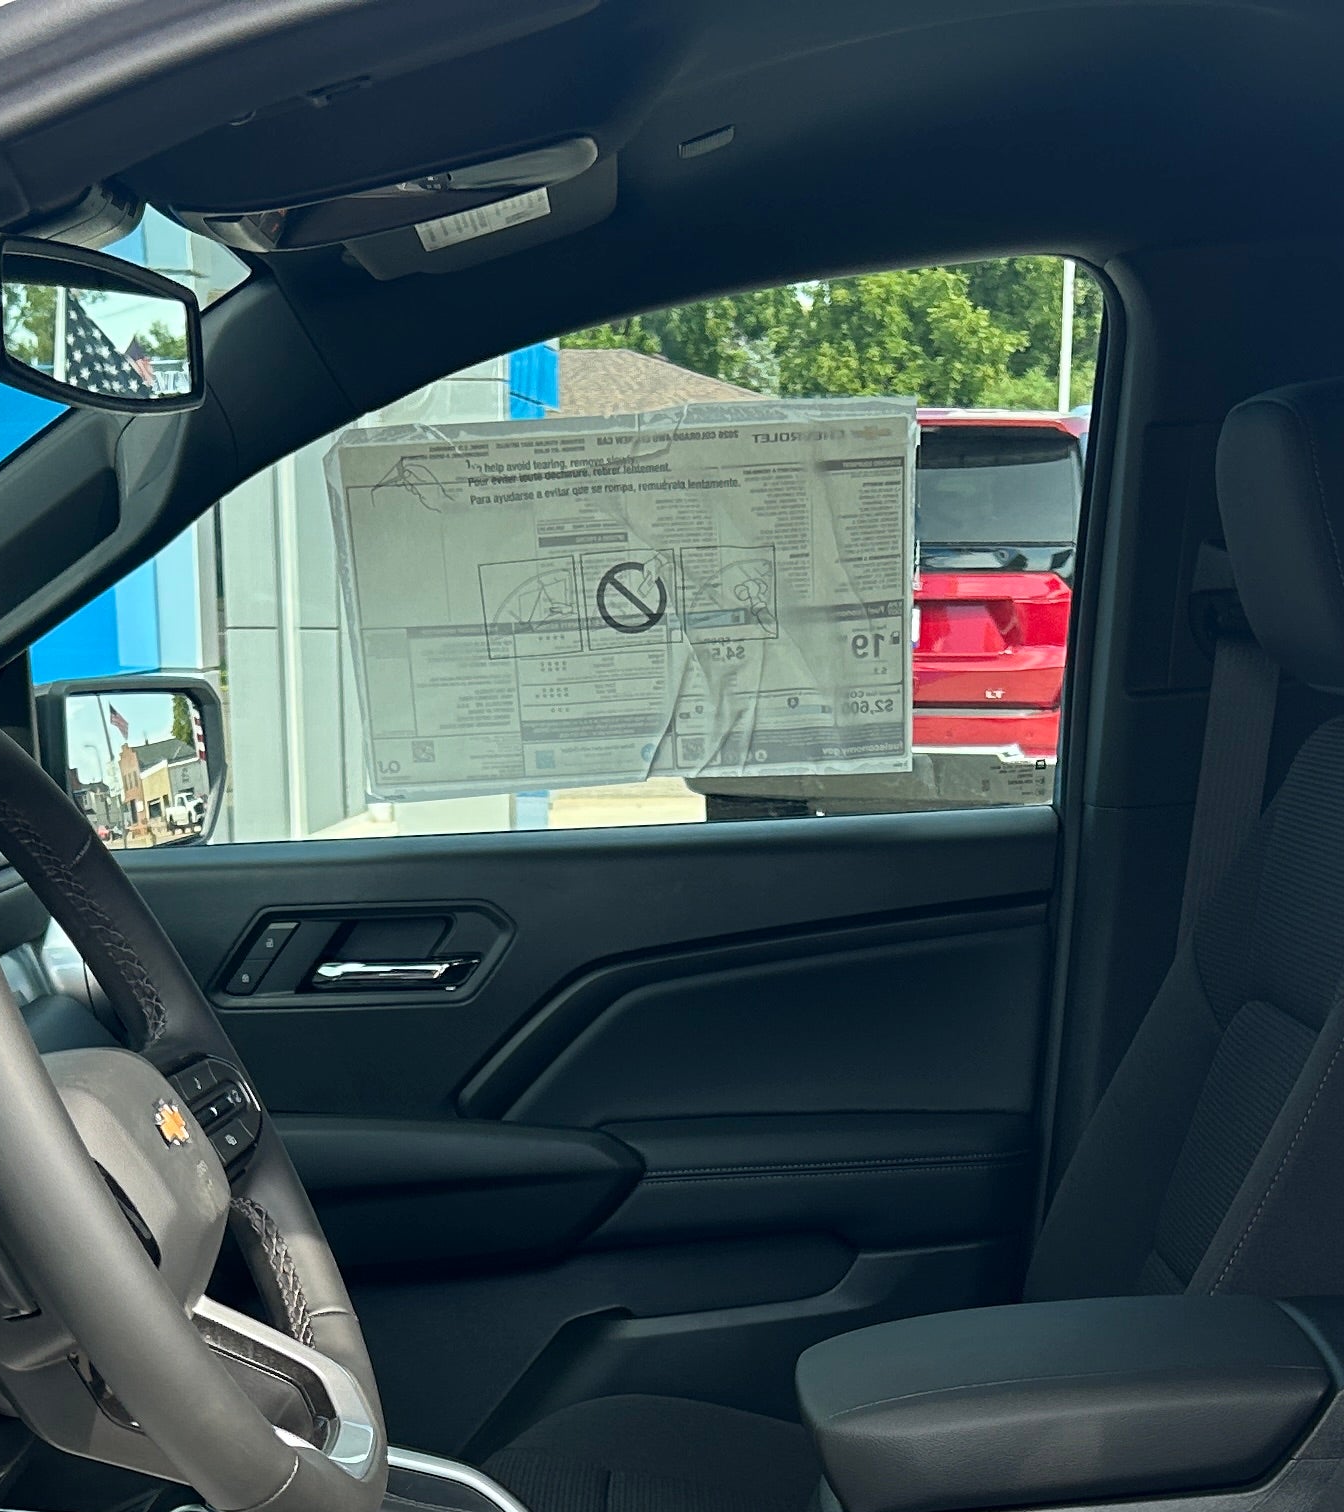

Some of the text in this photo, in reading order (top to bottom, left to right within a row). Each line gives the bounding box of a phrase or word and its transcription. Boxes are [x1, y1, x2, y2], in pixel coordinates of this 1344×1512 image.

[484, 462, 504, 473] help
[506, 460, 531, 472] avoid
[570, 457, 604, 468] remove
[470, 495, 491, 505] Para
[493, 490, 535, 504] ayudarse
[536, 490, 543, 499] a
[544, 487, 570, 499] evitar
[572, 485, 589, 497] que
[592, 484, 602, 493] se
